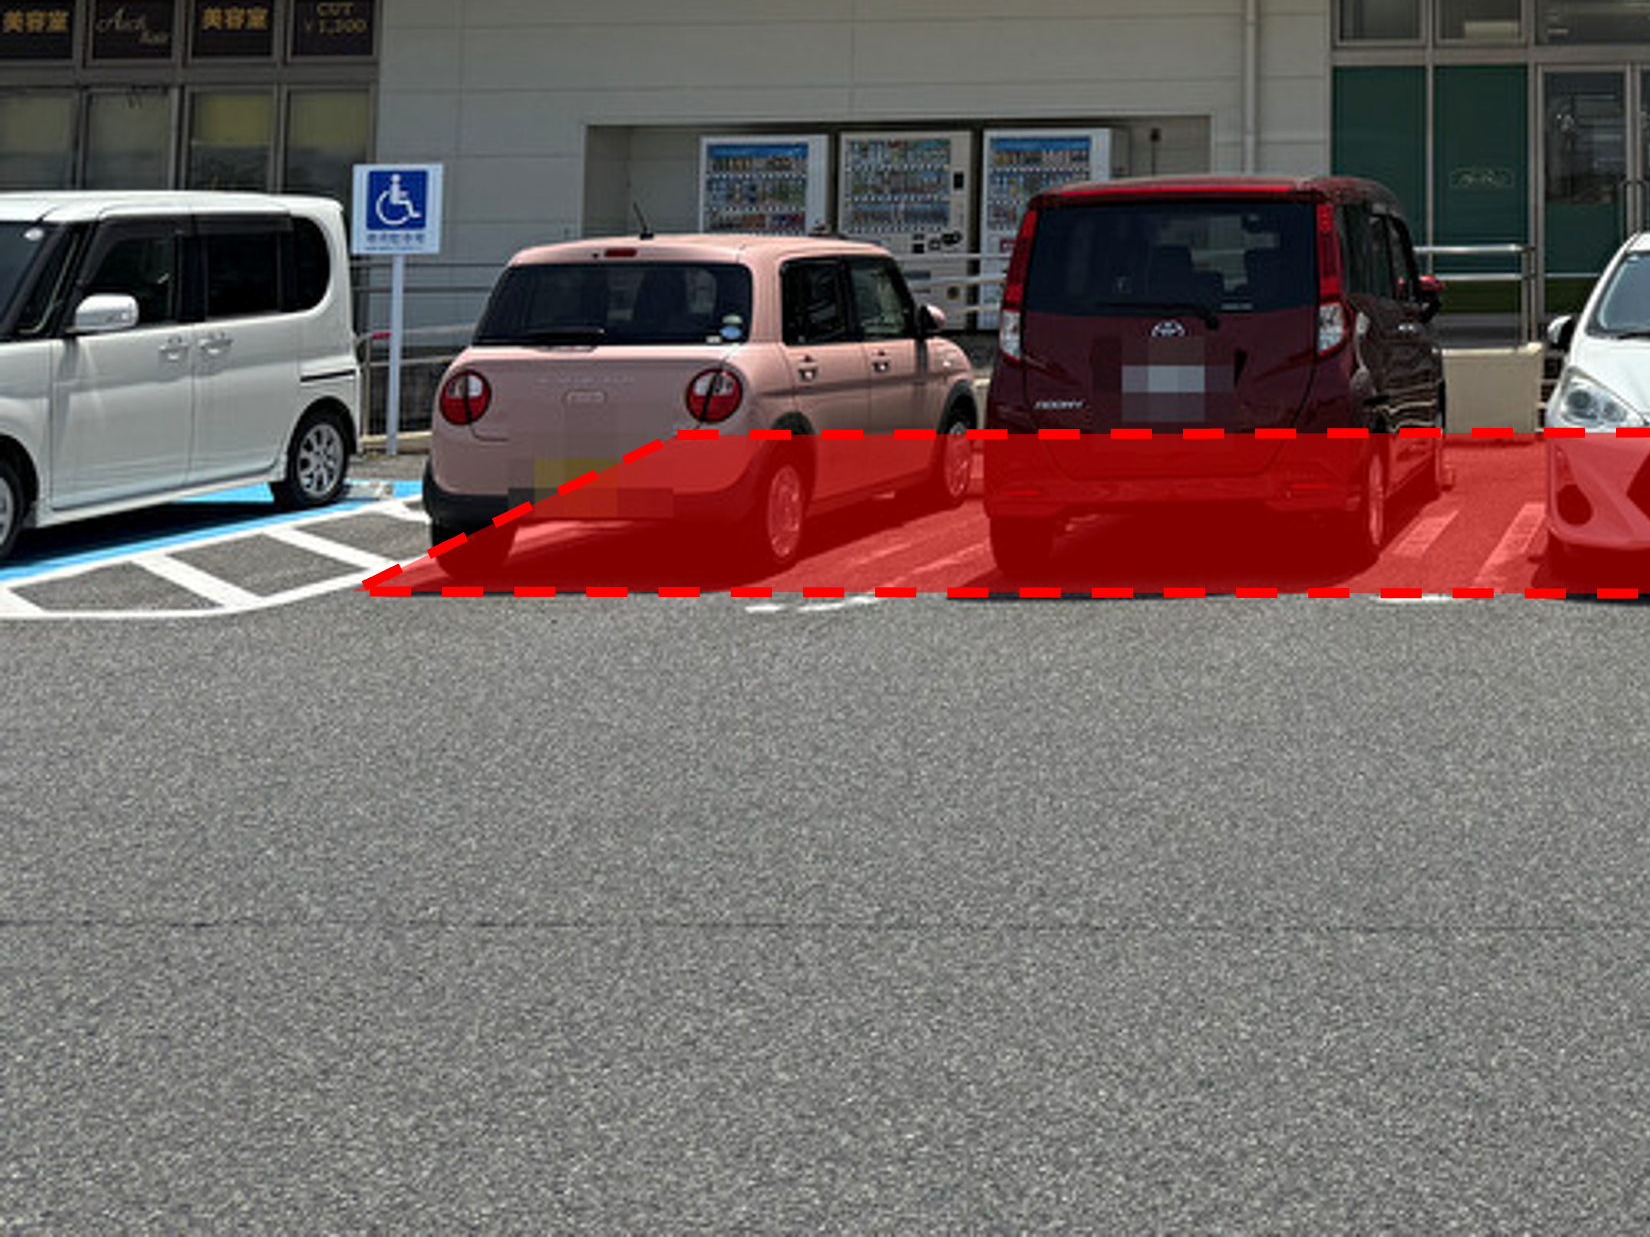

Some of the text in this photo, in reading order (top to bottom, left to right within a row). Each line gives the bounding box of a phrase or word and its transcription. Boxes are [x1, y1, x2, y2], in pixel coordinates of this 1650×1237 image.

[202, 6, 268, 31] 美容室
[316, 2, 354, 17] CUT
